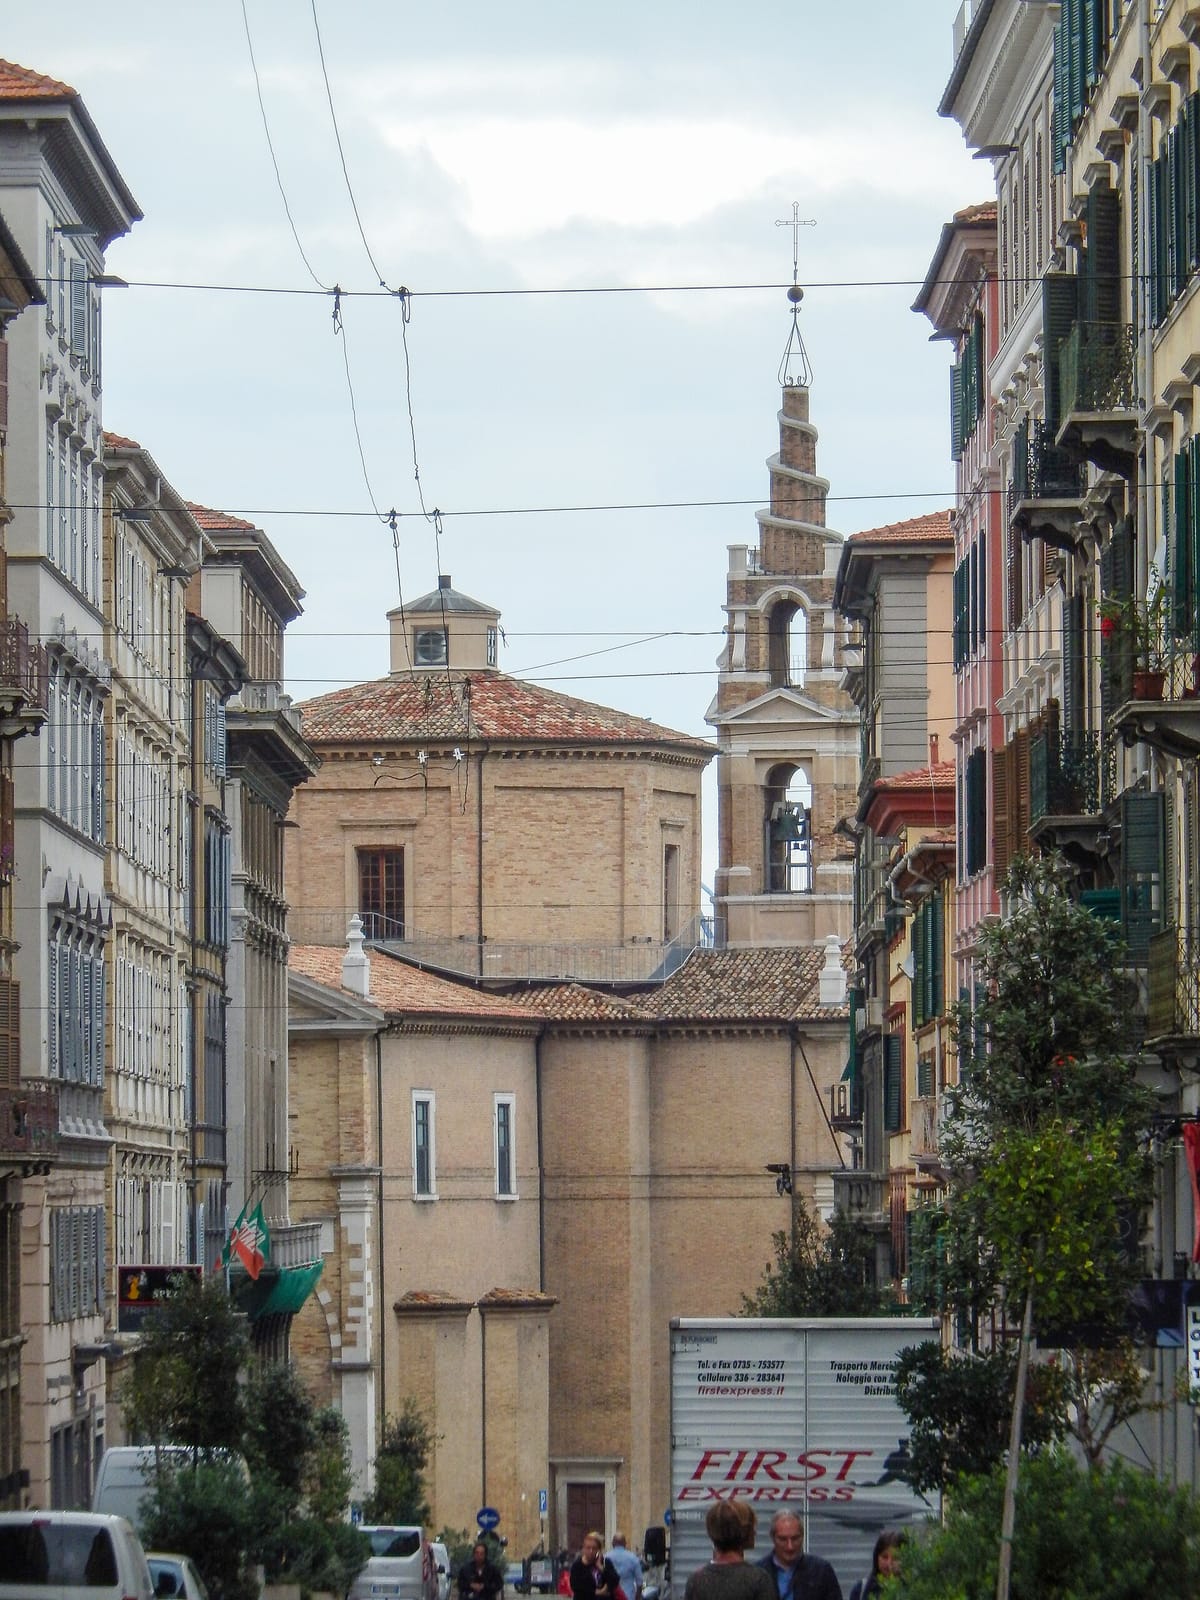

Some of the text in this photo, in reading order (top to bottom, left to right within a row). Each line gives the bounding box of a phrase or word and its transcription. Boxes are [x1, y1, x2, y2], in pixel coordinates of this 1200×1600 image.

[697, 1360, 710, 1369] Tel.
[718, 1360, 731, 1369] Fax
[732, 1360, 751, 1369] 0735
[758, 1360, 785, 1369] 753577
[830, 1361, 868, 1371] Trasporto
[697, 1373, 732, 1382] Cellulare
[734, 1373, 749, 1382] 336
[756, 1373, 785, 1382] 283641
[836, 1373, 872, 1384] Noleggio
[873, 1374, 887, 1383] con
[697, 1386, 785, 1397] firstexpress.it
[690, 1450, 875, 1481] FIRST
[677, 1486, 856, 1501] EXPRESS
